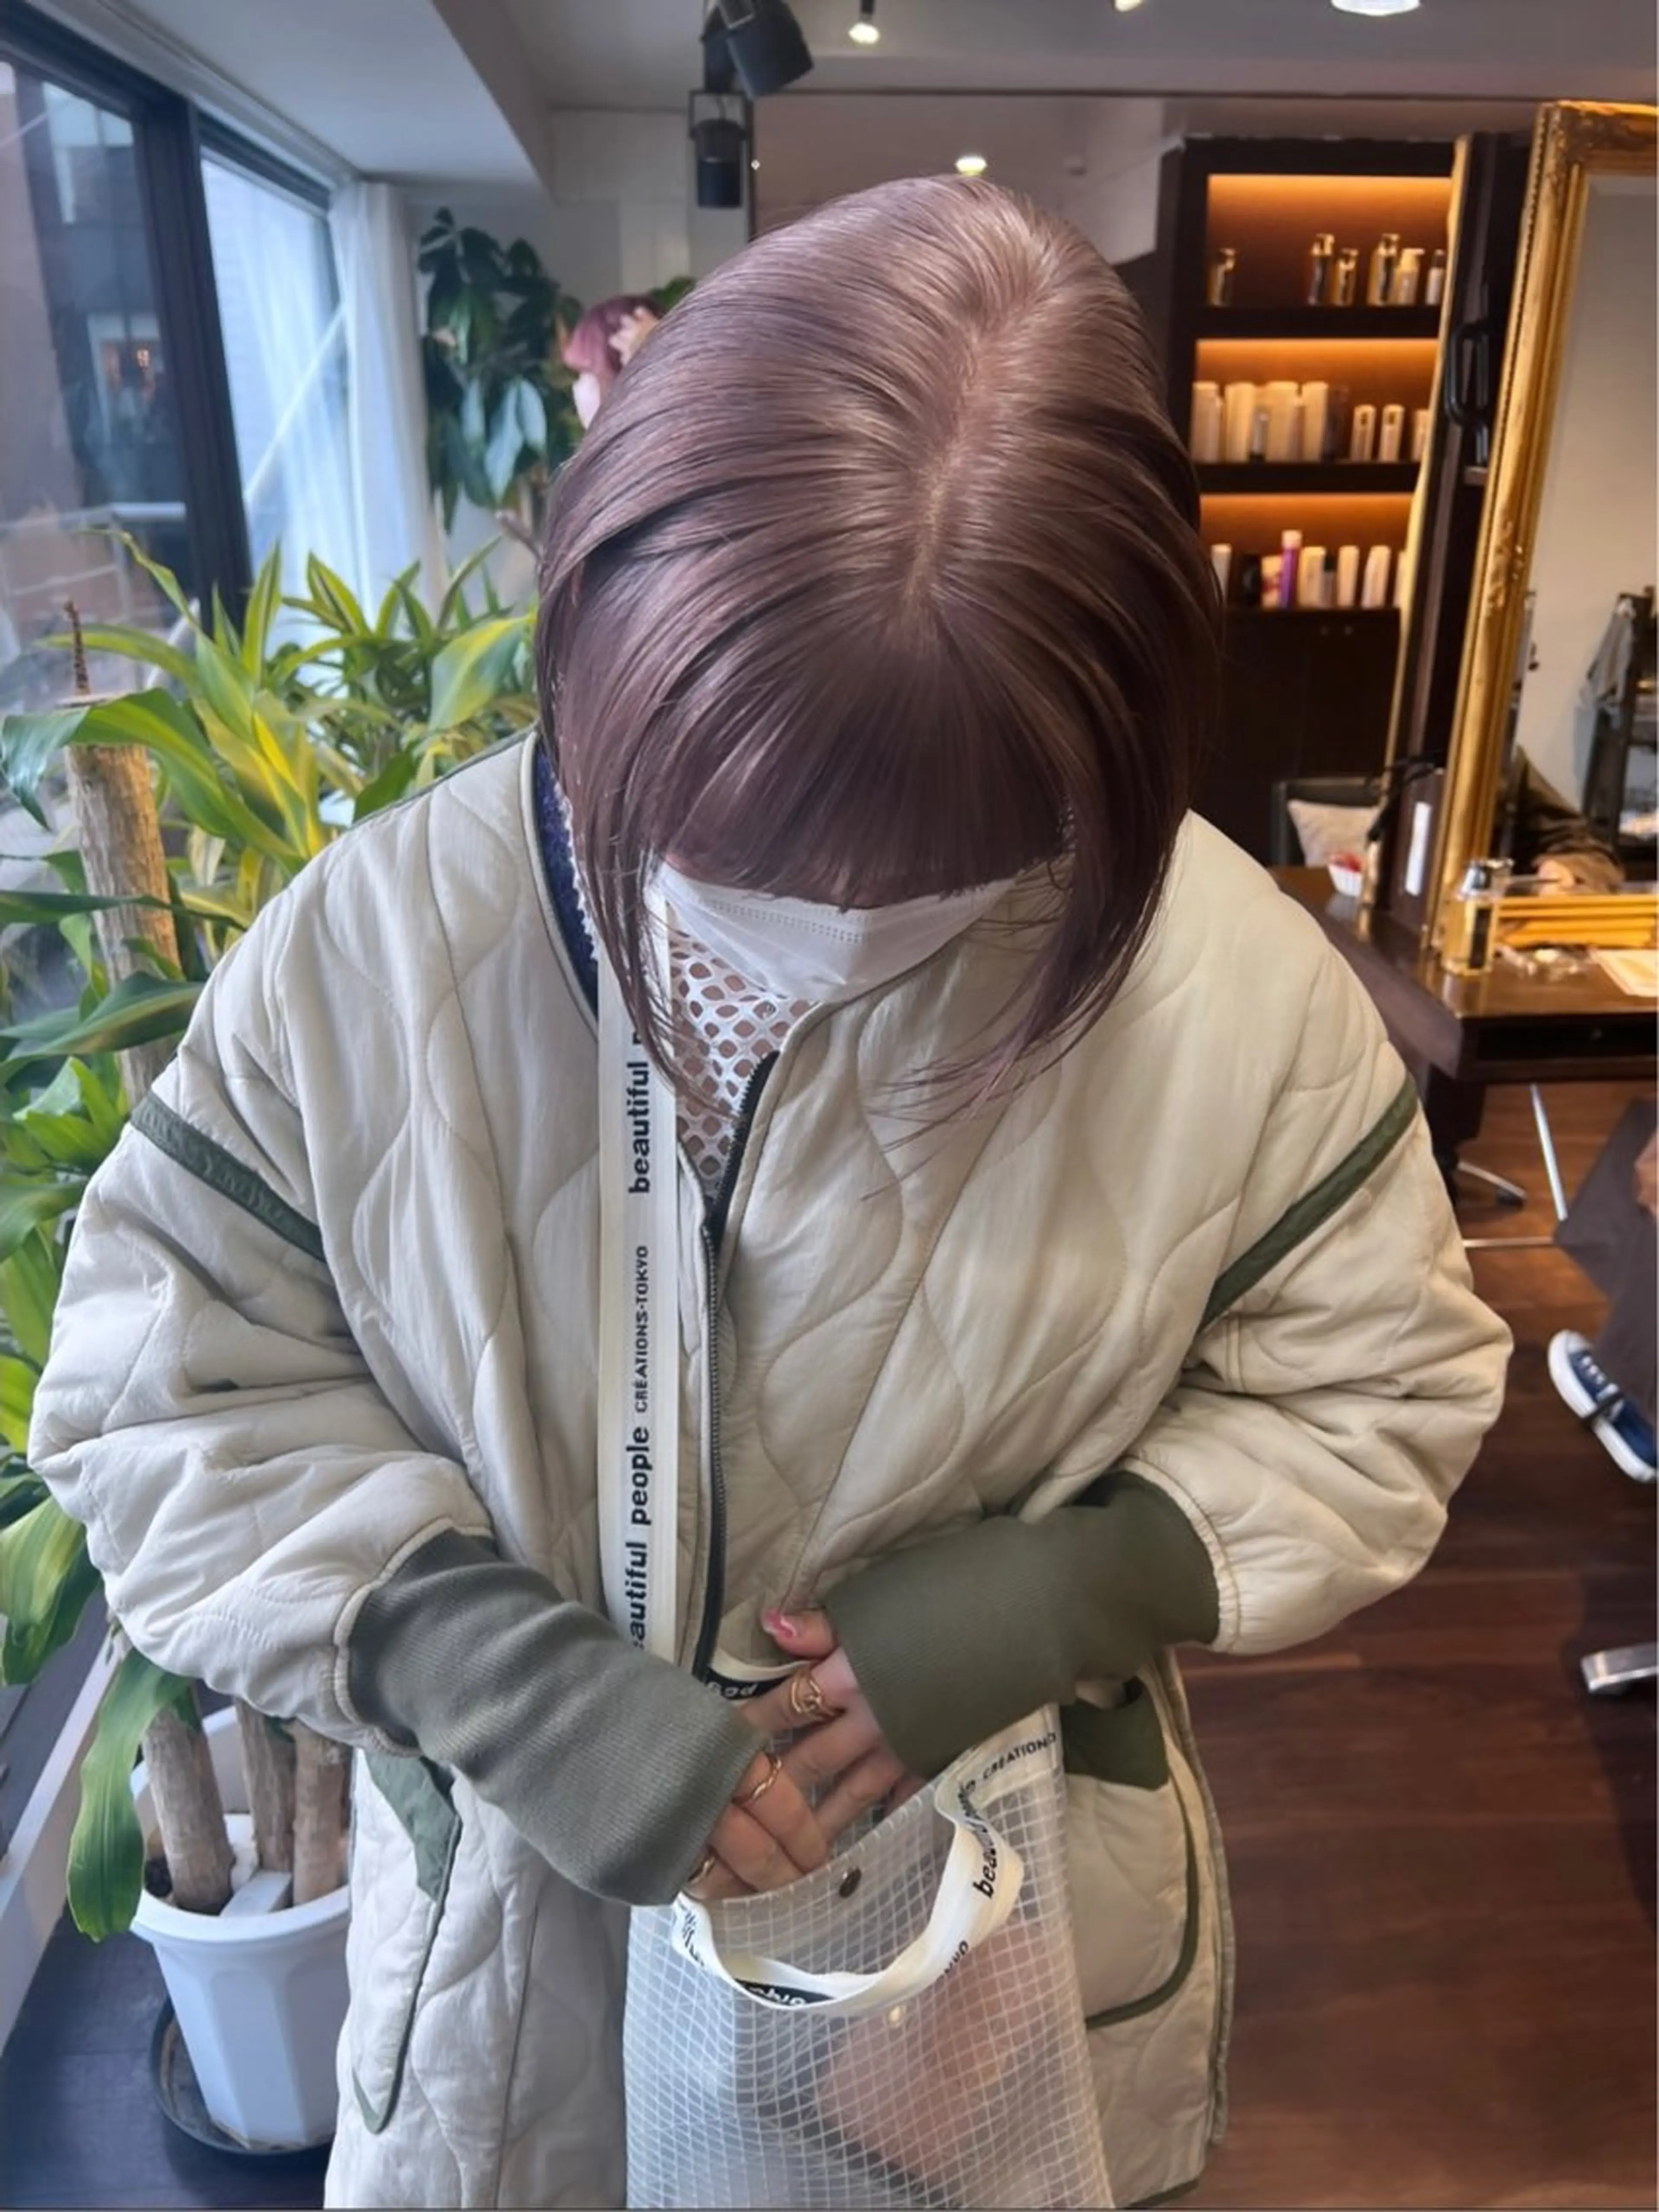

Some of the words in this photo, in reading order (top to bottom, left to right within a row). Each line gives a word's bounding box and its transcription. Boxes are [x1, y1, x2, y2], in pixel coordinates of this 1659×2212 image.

[627, 1062, 650, 1194] beautiful
[625, 1427, 652, 1526] people
[625, 1541, 648, 1649] autiful
